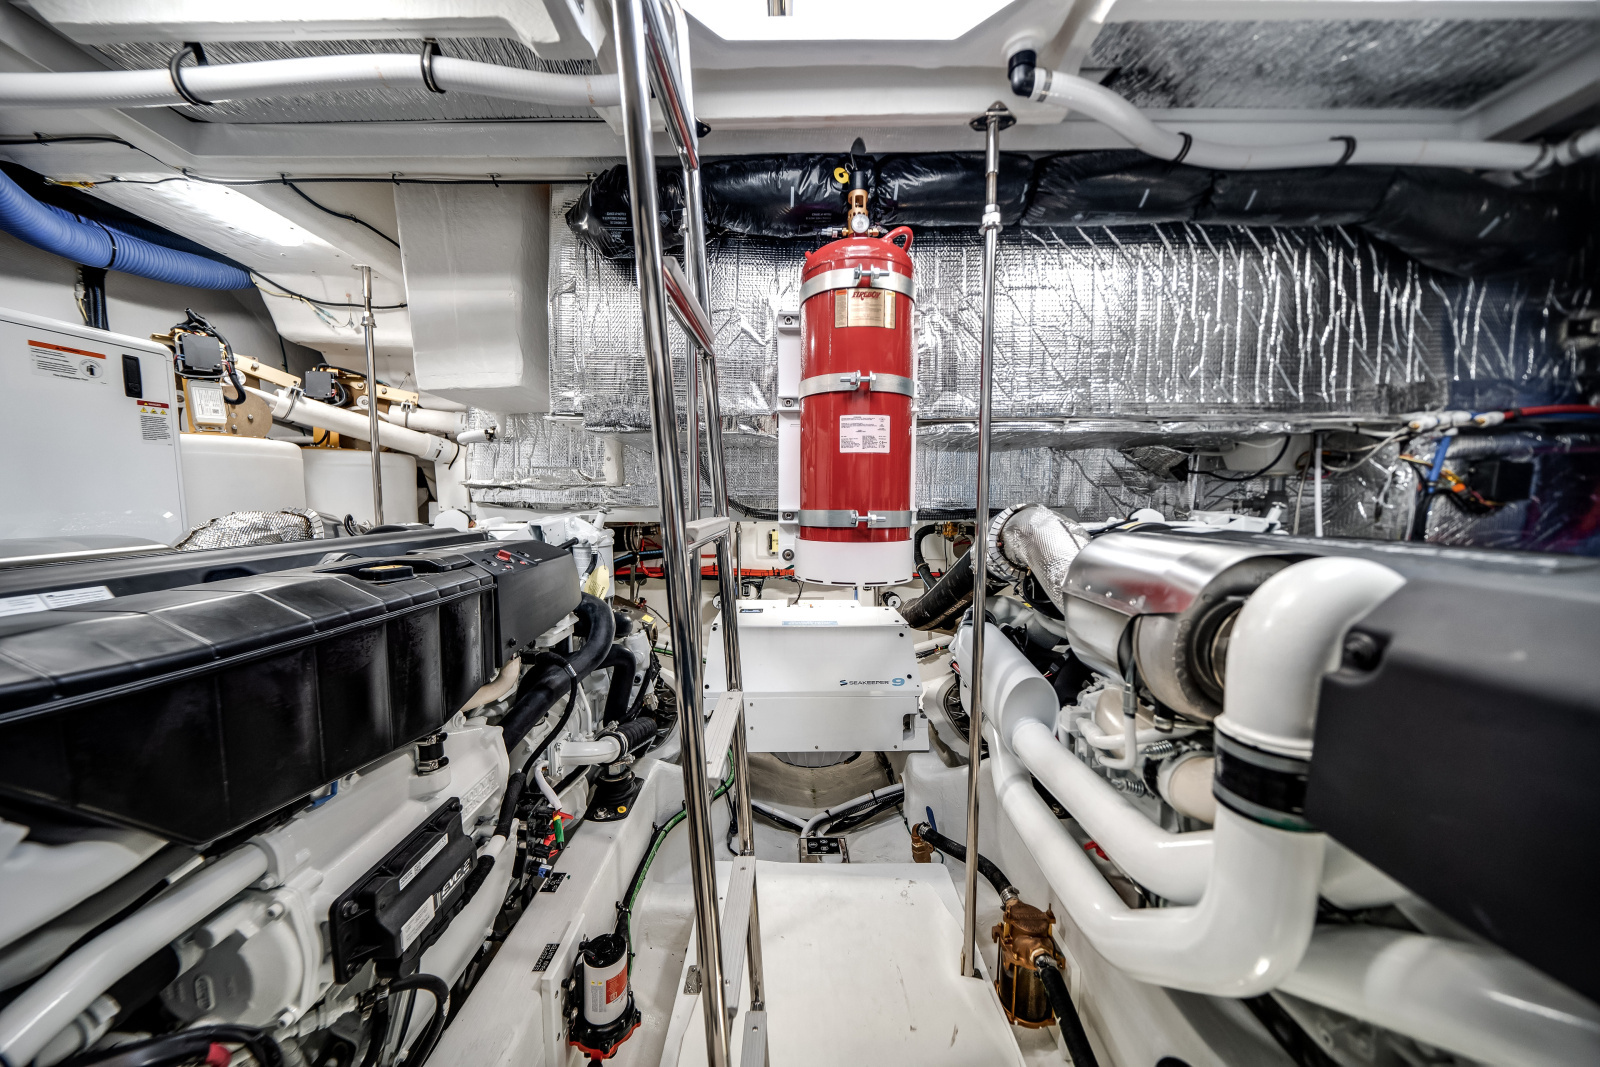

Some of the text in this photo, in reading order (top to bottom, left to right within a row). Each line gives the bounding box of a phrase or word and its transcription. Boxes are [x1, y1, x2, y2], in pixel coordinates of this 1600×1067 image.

[851, 291, 881, 301] FIREBOY
[892, 677, 905, 686] 9
[441, 868, 463, 895] EVC
[534, 944, 551, 971] SEAKEEPER
[546, 944, 557, 960] WATER
